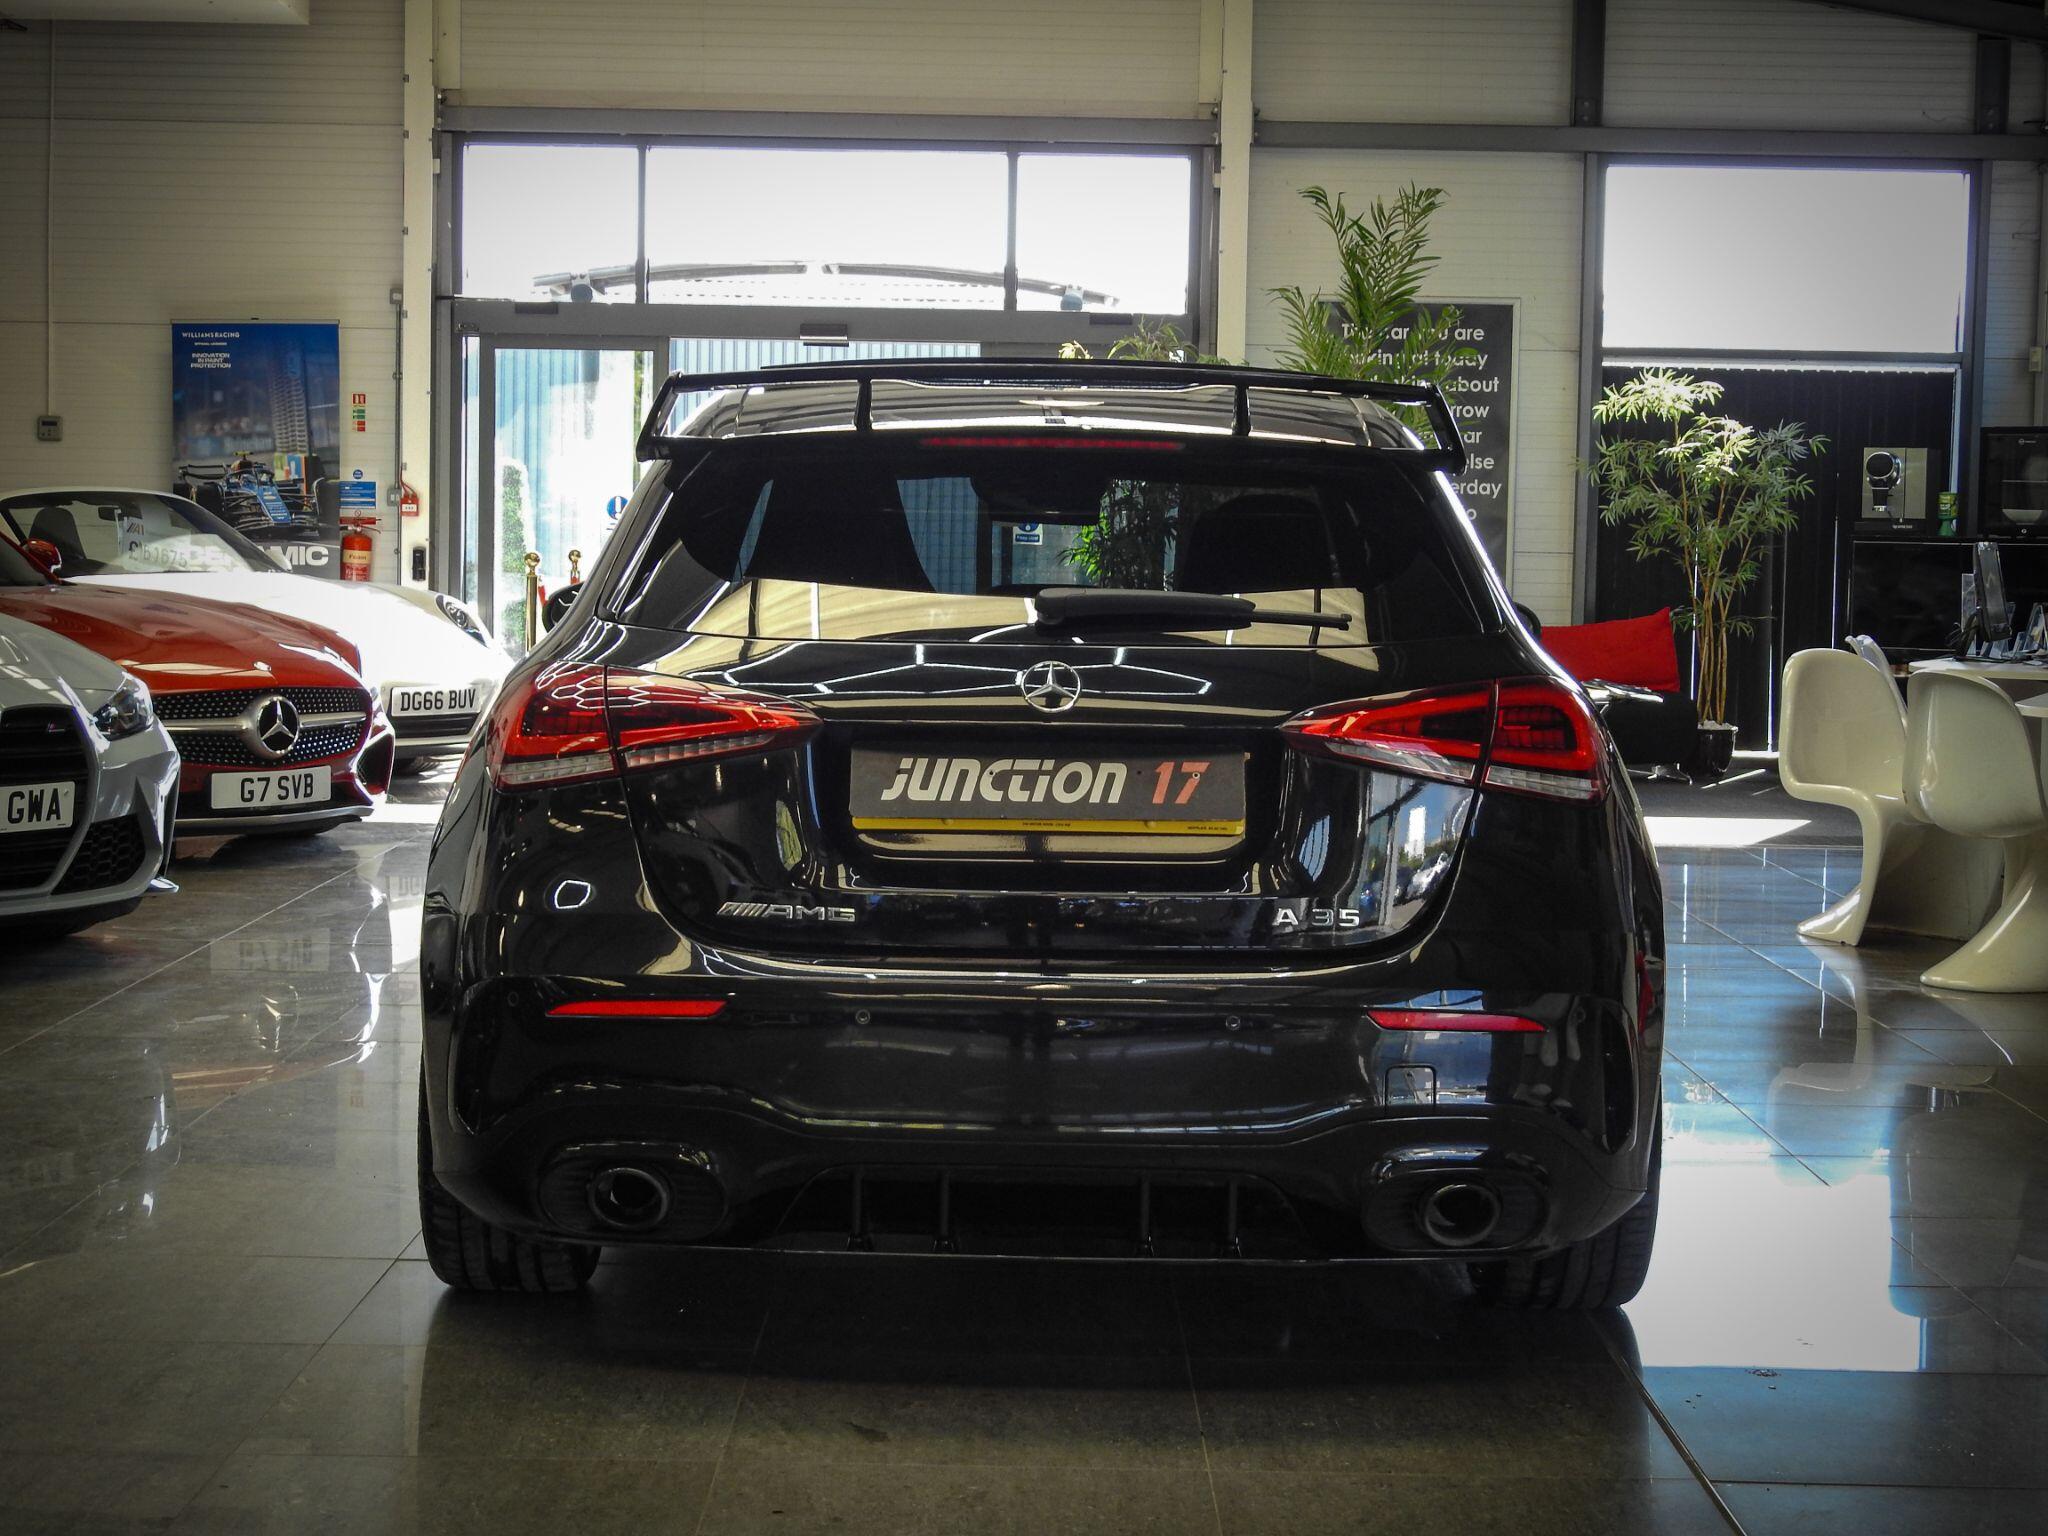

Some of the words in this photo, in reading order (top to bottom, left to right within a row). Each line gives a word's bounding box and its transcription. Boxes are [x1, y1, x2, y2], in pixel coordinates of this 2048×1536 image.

[1454, 328, 1485, 341] are
[1451, 405, 1490, 418] rrow
[1463, 431, 1483, 444] ar
[1466, 453, 1495, 469] lse
[1450, 479, 1502, 498] erday
[400, 691, 444, 711] DG66
[448, 688, 476, 709] BUV
[240, 777, 270, 803] G7
[277, 773, 313, 800] SVB
[1152, 761, 1210, 804] 17
[7, 788, 61, 824] GWA
[1272, 908, 1299, 926] A
[1312, 908, 1360, 927] 35
